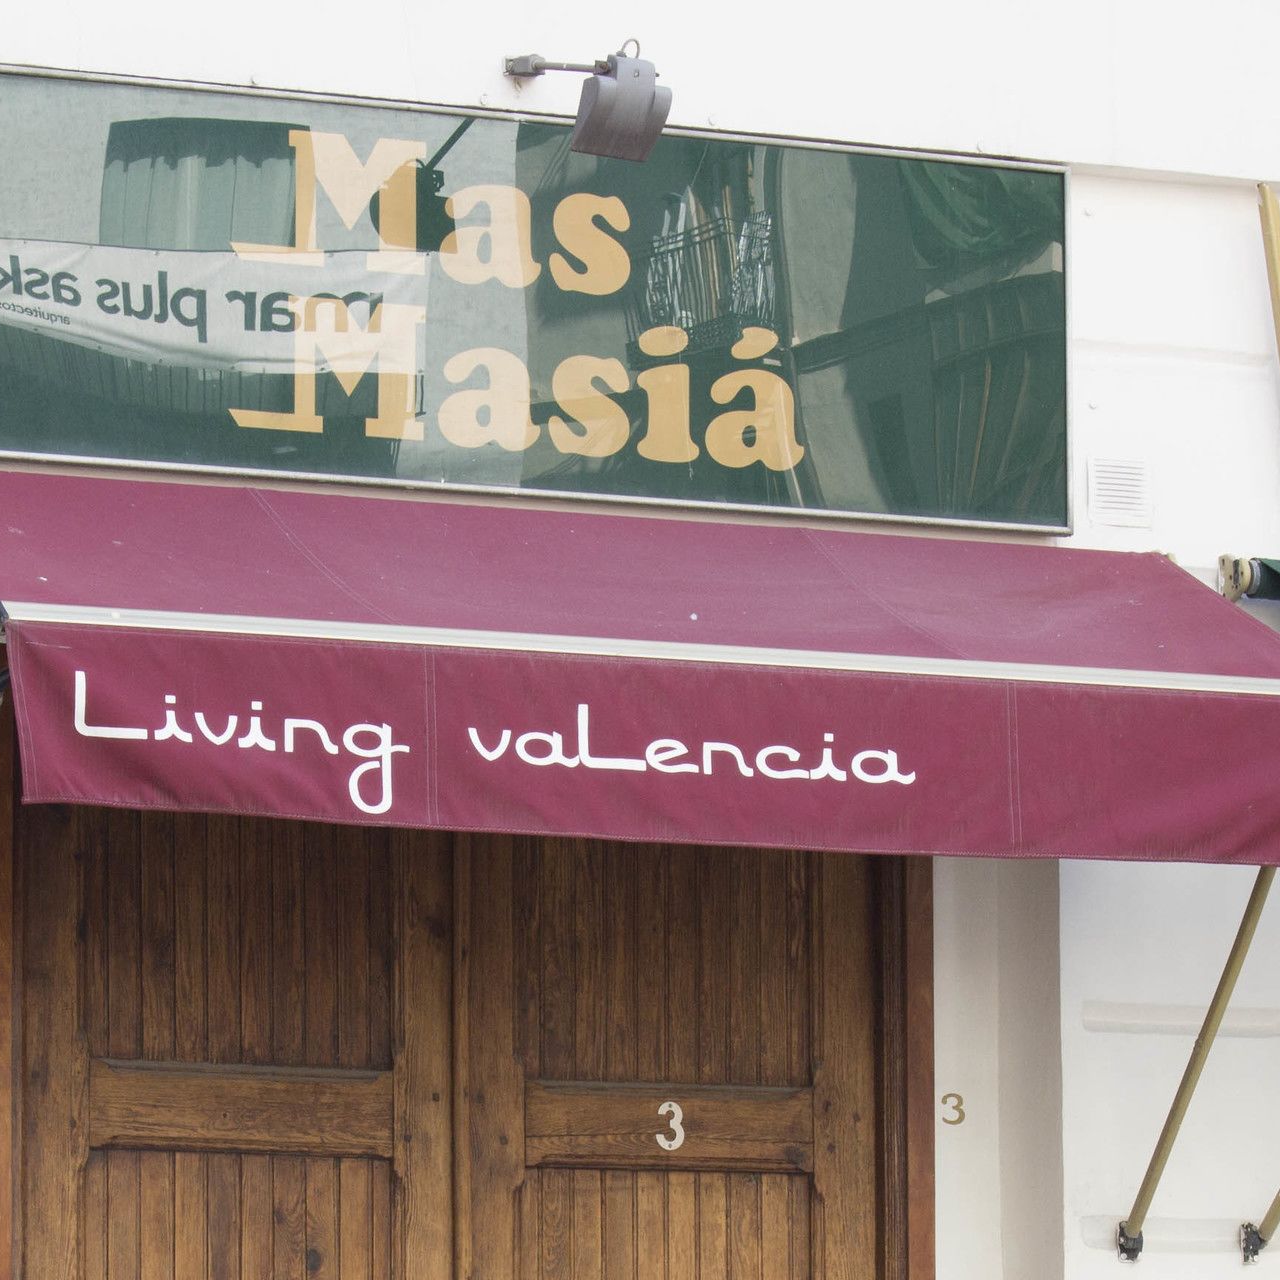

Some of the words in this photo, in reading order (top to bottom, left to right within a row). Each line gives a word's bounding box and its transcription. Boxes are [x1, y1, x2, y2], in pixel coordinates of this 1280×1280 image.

[229, 129, 631, 295] Mas
[228, 295, 804, 472] Masiá
[74, 670, 409, 815] Living
[656, 1102, 685, 1151] 3
[941, 1093, 965, 1126] 3
